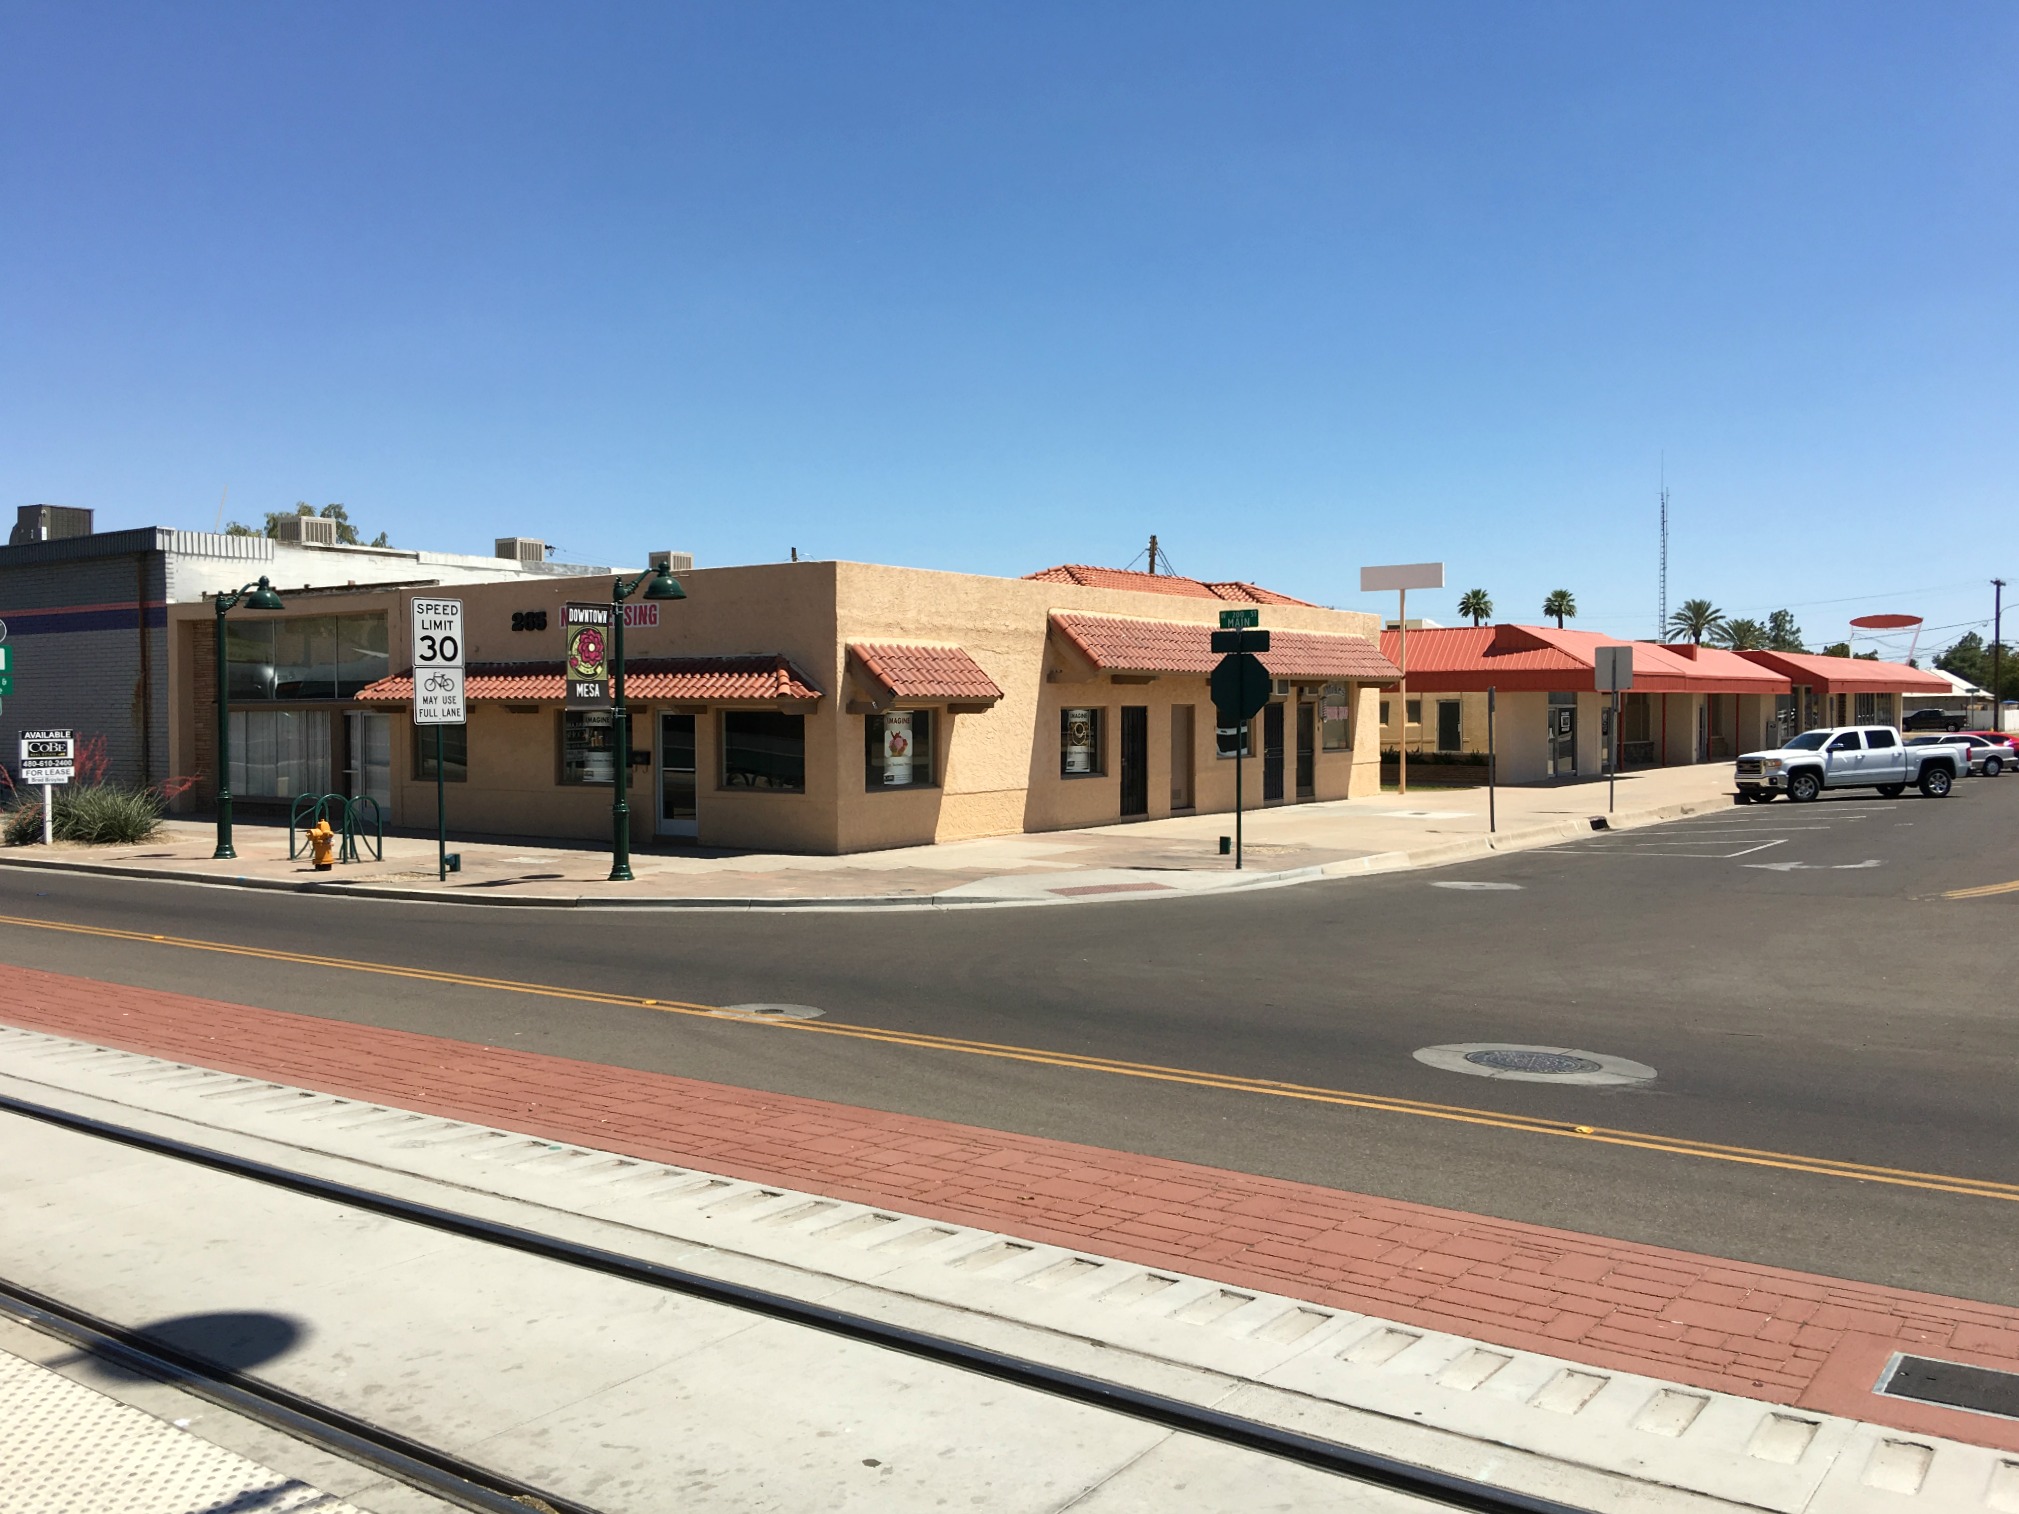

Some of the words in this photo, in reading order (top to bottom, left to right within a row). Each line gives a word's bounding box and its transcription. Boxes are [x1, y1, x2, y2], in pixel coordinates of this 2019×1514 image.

[416, 603, 459, 616] SPEED
[568, 608, 608, 624] DOWNTOWN
[608, 604, 658, 627] ESING
[421, 619, 454, 631] LIMIT
[1227, 617, 1250, 628] MAIN
[418, 634, 459, 662] 30
[576, 683, 600, 698] MESA
[422, 695, 438, 705] MAY
[442, 695, 457, 705] USE
[419, 708, 438, 717] FULL
[442, 708, 461, 717] LANE
[585, 716, 610, 724] IMAGINE
[886, 717, 911, 725] IMAGINE
[24, 731, 71, 739] AVAILABLE
[26, 769, 43, 777] FOR
[45, 768, 71, 776] LEASE
